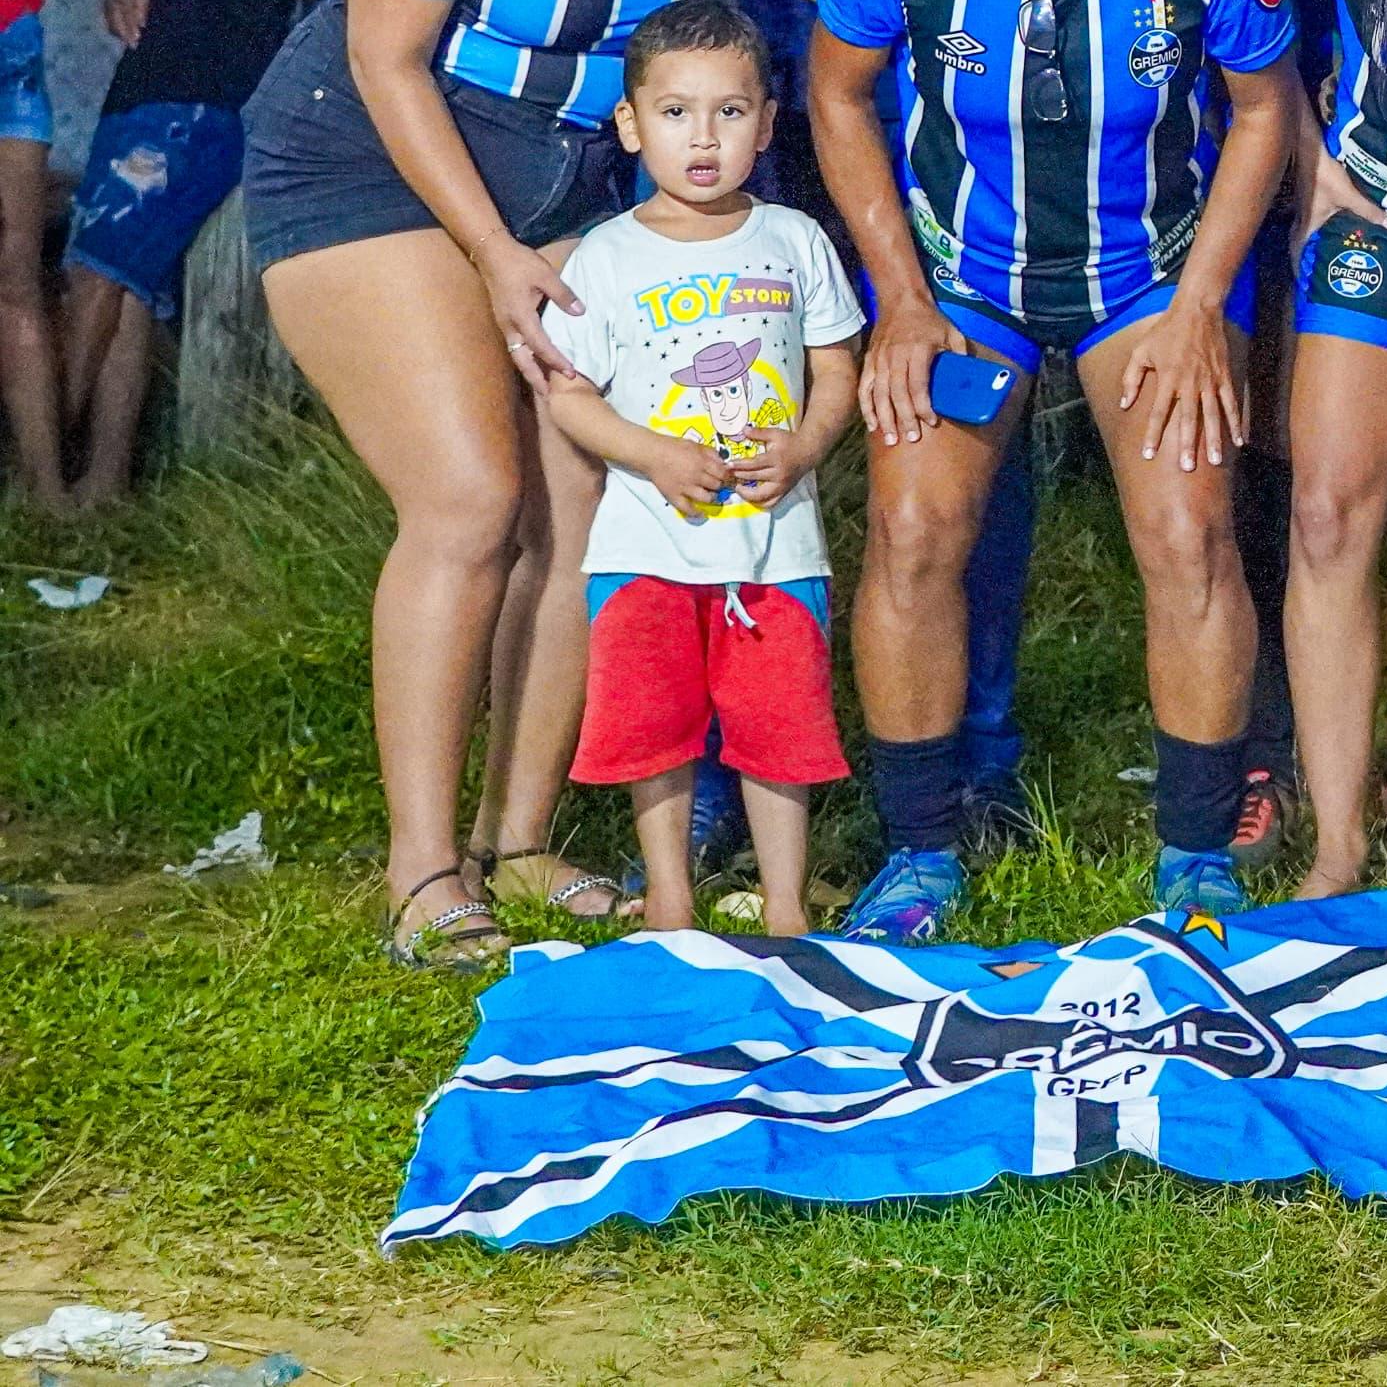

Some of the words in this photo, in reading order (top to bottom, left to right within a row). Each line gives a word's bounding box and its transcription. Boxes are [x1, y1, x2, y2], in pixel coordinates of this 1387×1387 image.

[934, 48, 985, 75] umbro
[637, 275, 737, 332] TOY
[730, 286, 792, 306] STORY
